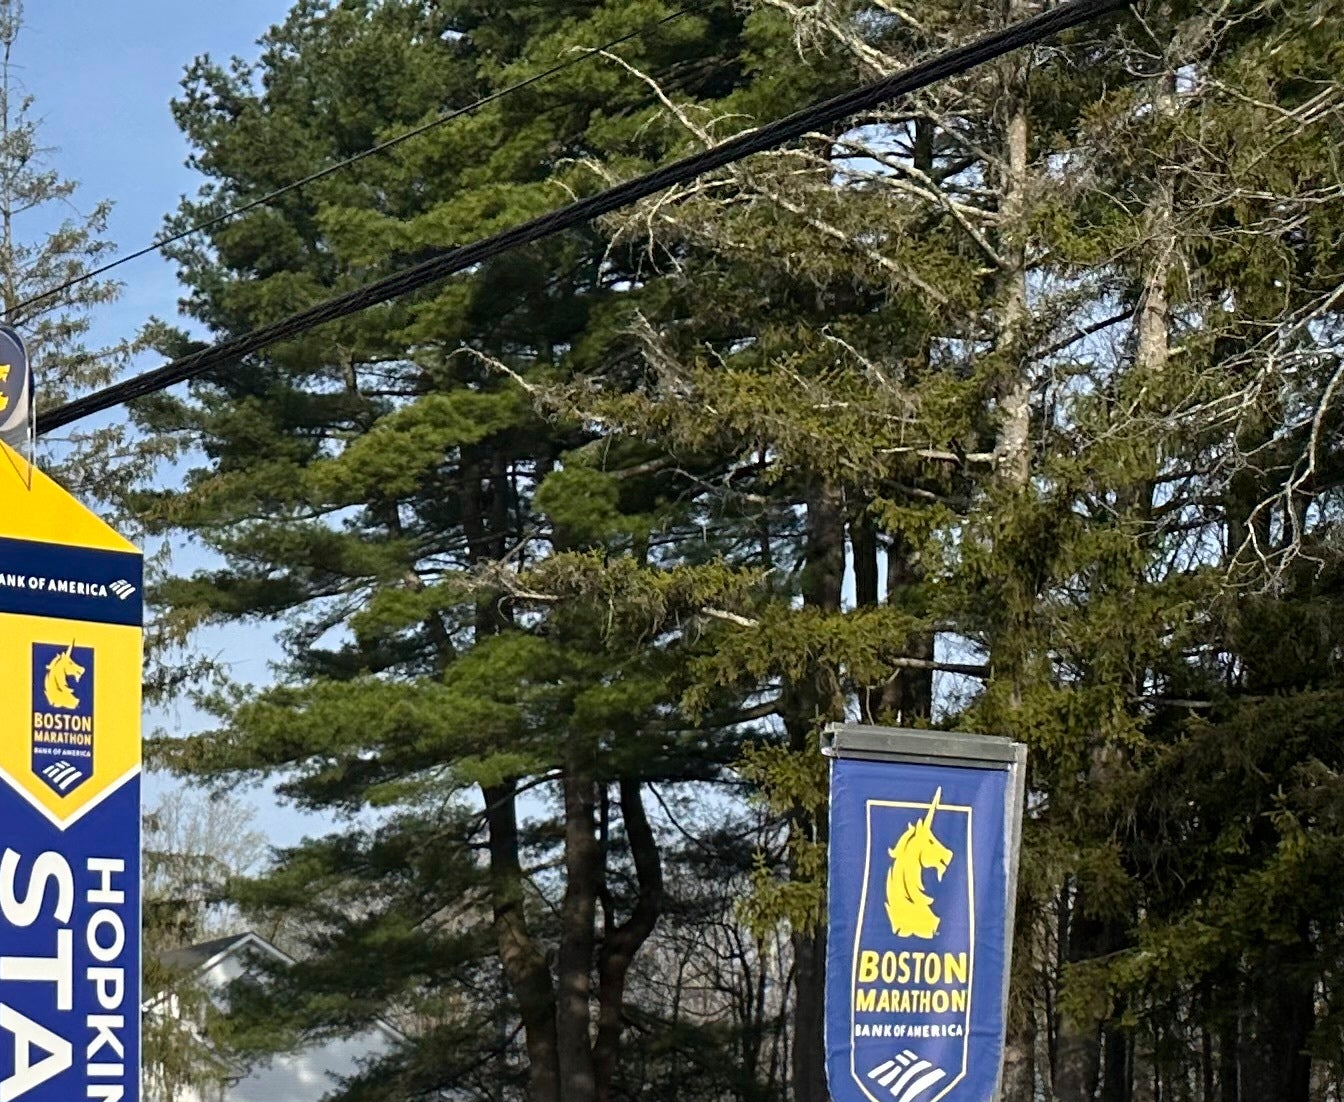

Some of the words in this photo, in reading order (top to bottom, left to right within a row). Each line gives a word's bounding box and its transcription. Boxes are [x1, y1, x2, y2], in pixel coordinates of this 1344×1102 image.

[27, 576, 47, 590] OF
[47, 578, 108, 598] AMERICA
[33, 711, 92, 732] BOSTON
[33, 730, 92, 746] MARATHON
[33, 746, 52, 755] BANK
[62, 749, 92, 758] AMERICA
[858, 950, 967, 985] BOSTON
[855, 988, 967, 1013] MARATHON
[855, 1024, 892, 1037] BANK
[893, 1024, 906, 1037] OF
[906, 1023, 963, 1038] AMERICA
